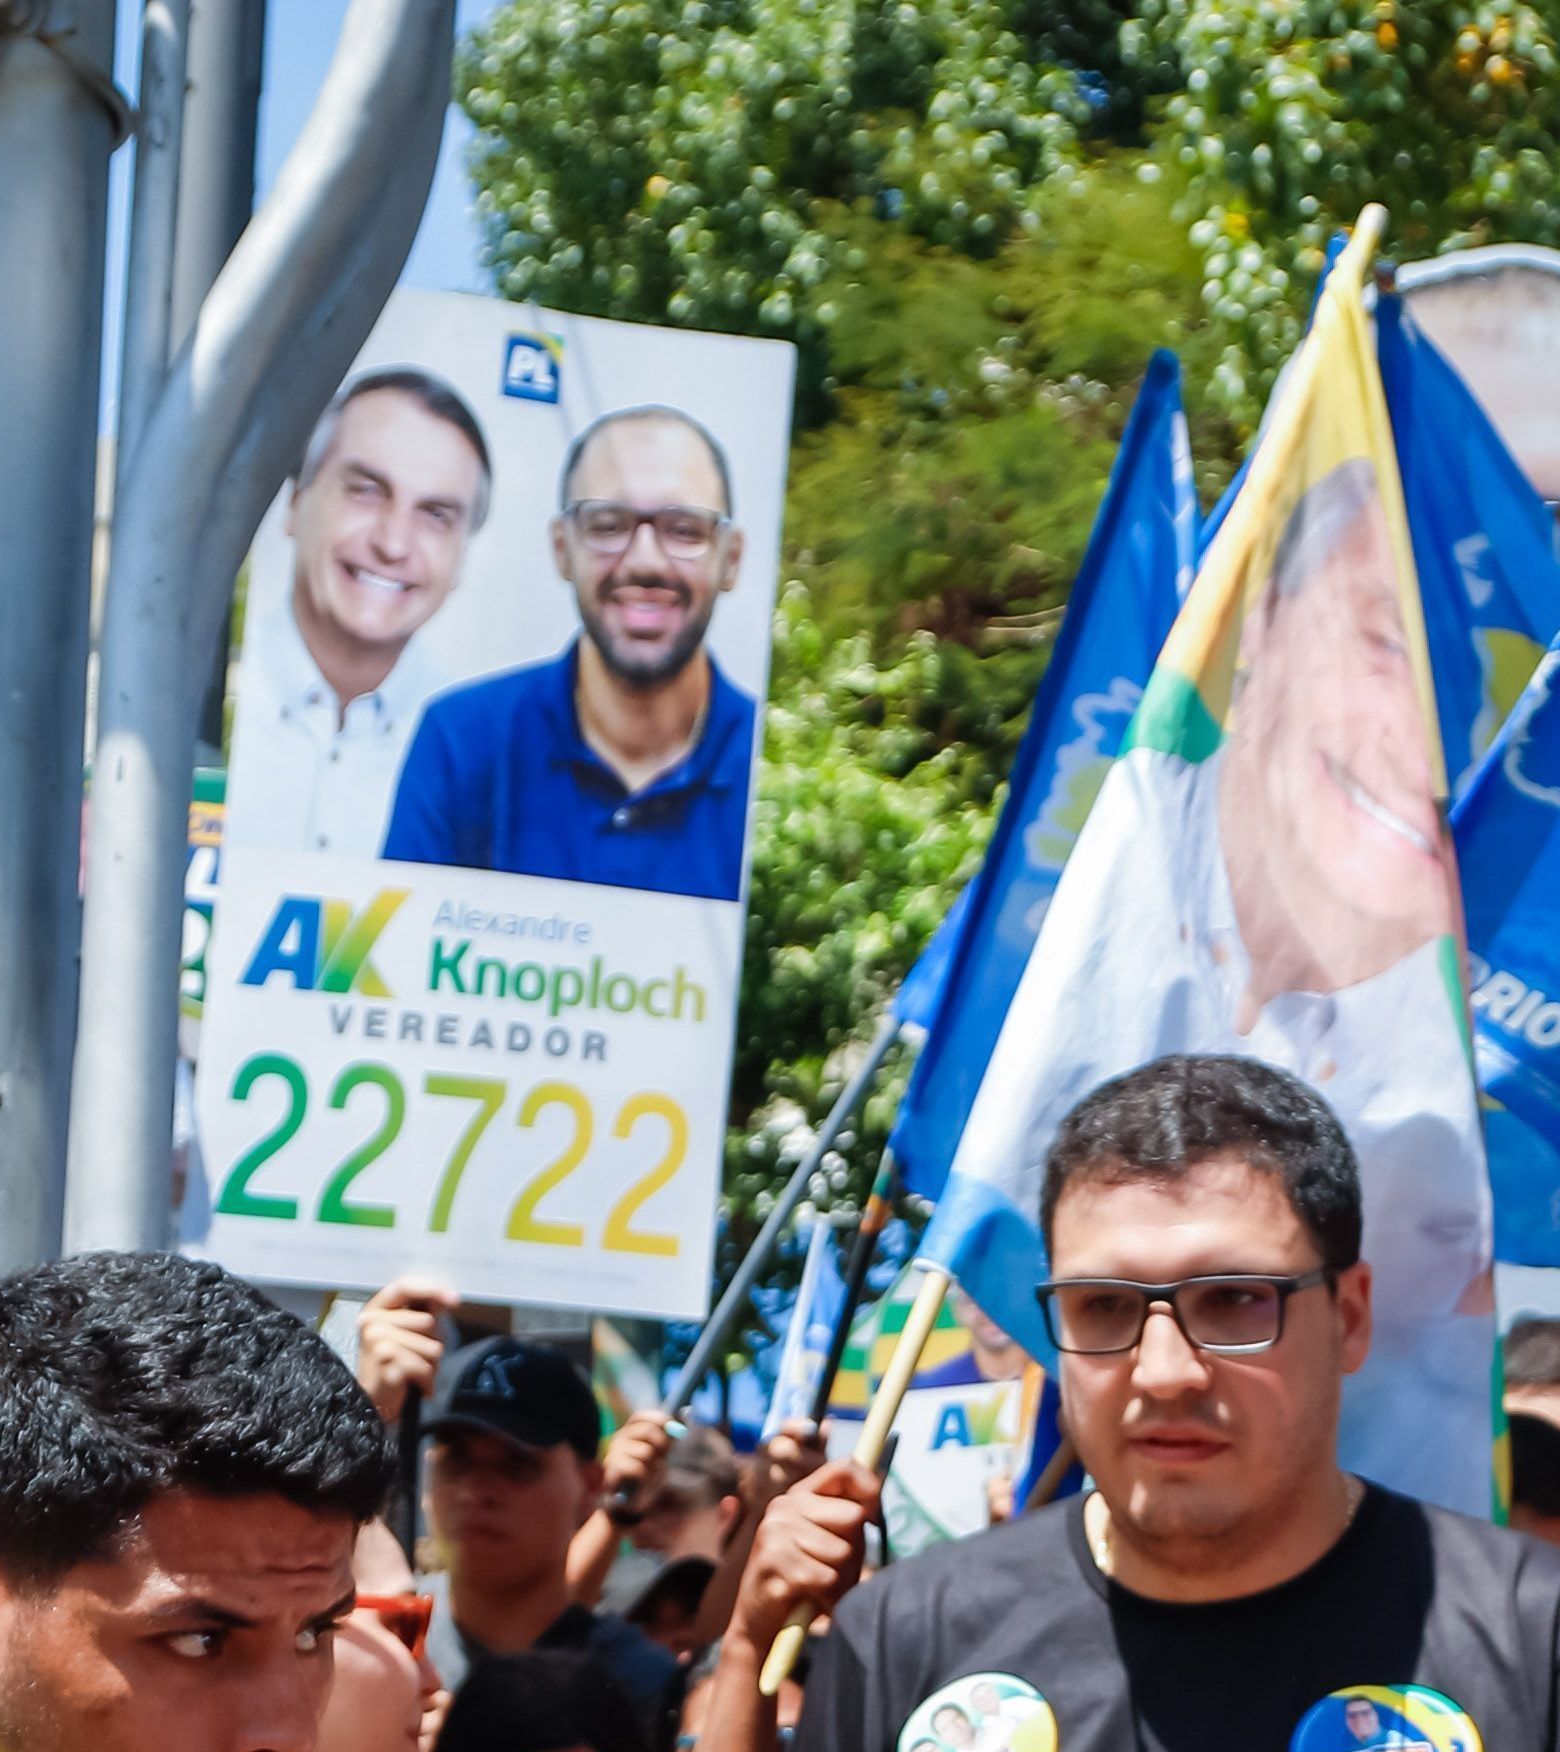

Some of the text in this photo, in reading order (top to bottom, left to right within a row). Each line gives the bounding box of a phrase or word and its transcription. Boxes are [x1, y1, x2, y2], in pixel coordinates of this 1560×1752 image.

[238, 887, 411, 997] AK
[432, 900, 592, 945] Alexandre
[428, 936, 707, 1024] Knoploch
[329, 1003, 609, 1062] VEREADOR
[216, 1050, 689, 1257] 22722
